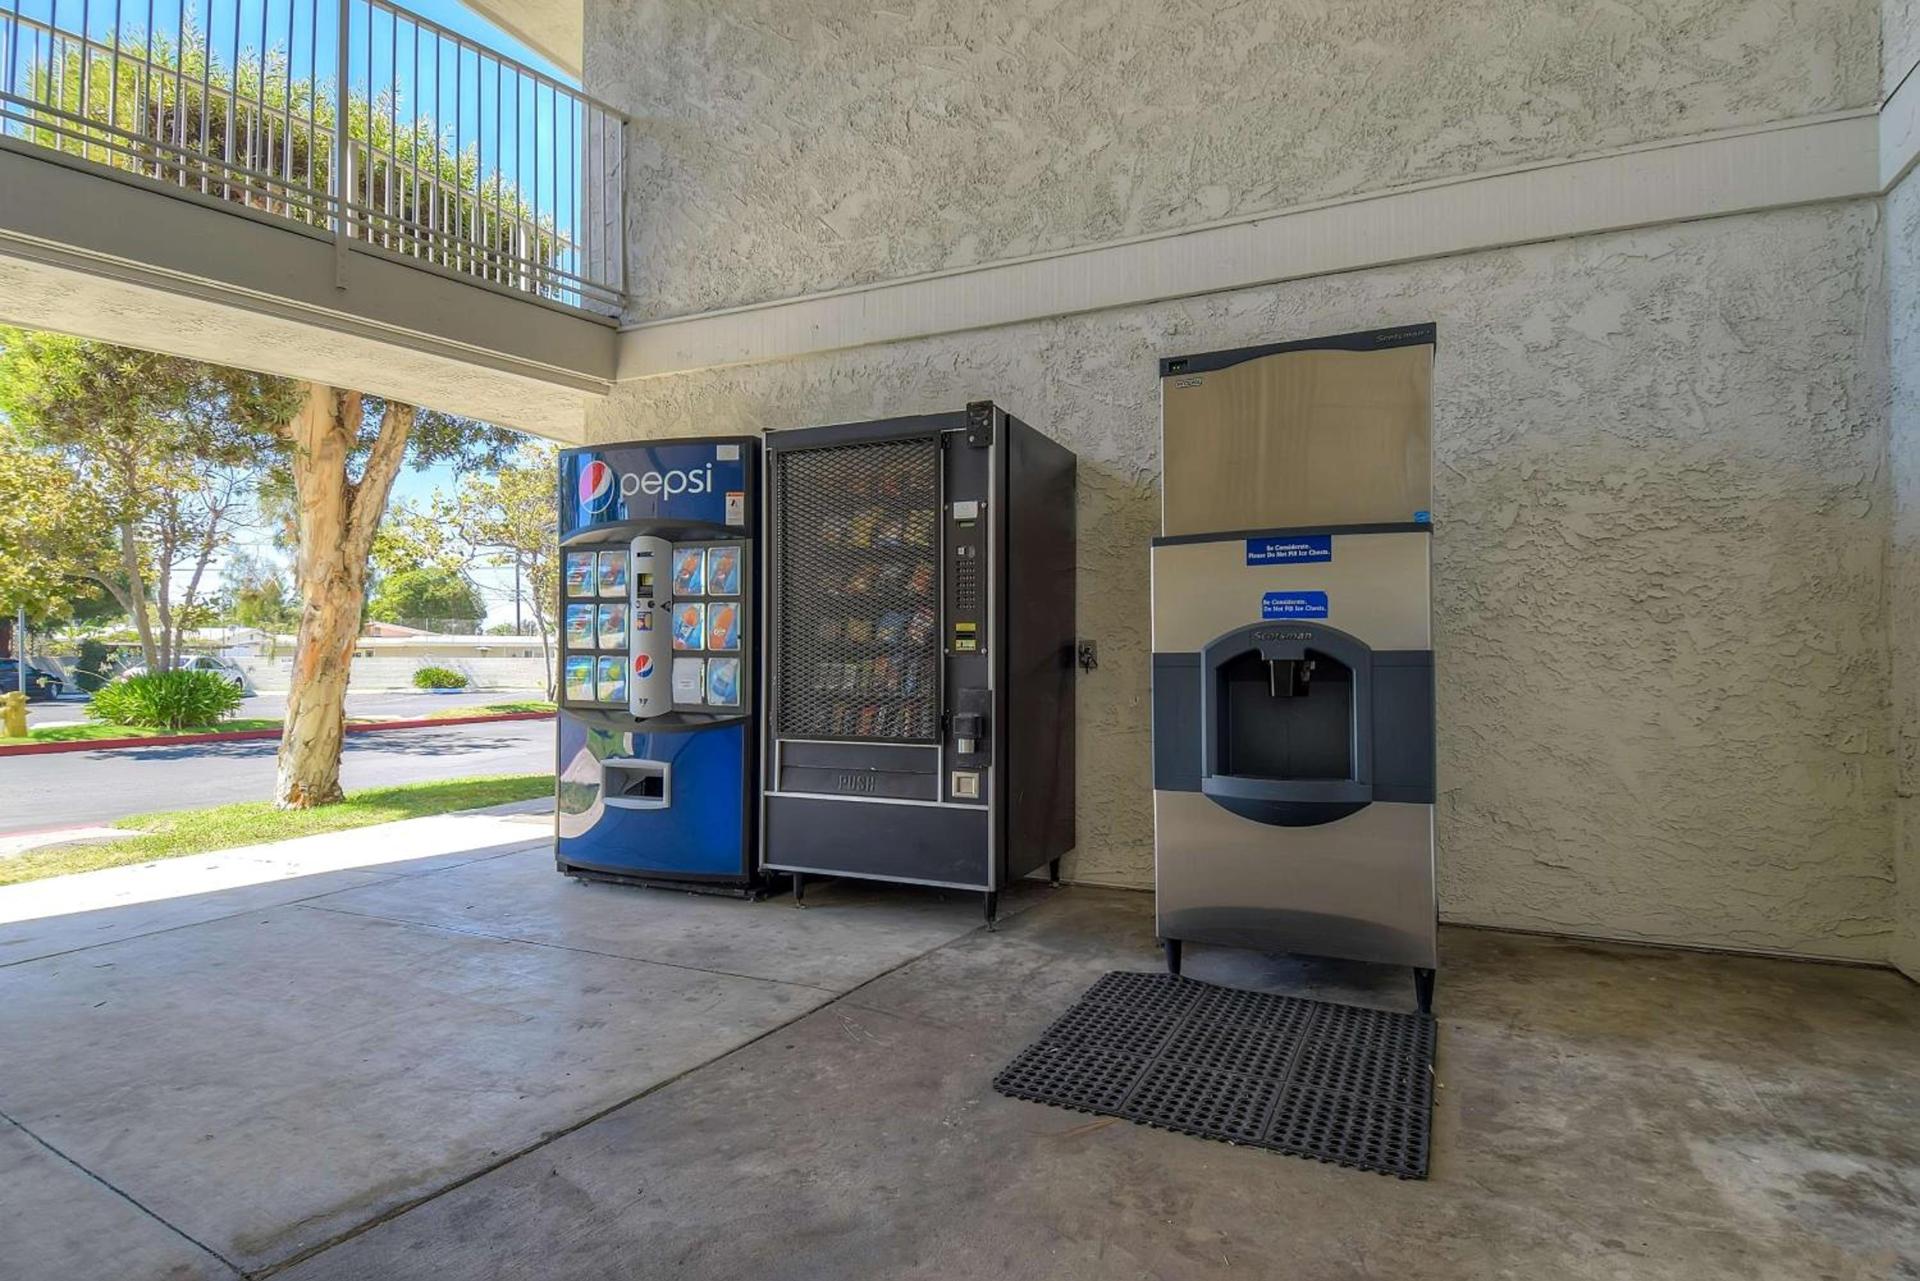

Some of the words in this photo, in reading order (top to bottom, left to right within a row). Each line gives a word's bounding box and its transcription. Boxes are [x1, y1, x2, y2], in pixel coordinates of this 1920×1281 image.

[620, 463, 713, 502] pepsi
[1254, 631, 1312, 641] Scotsman
[838, 775, 876, 792] PUSH
